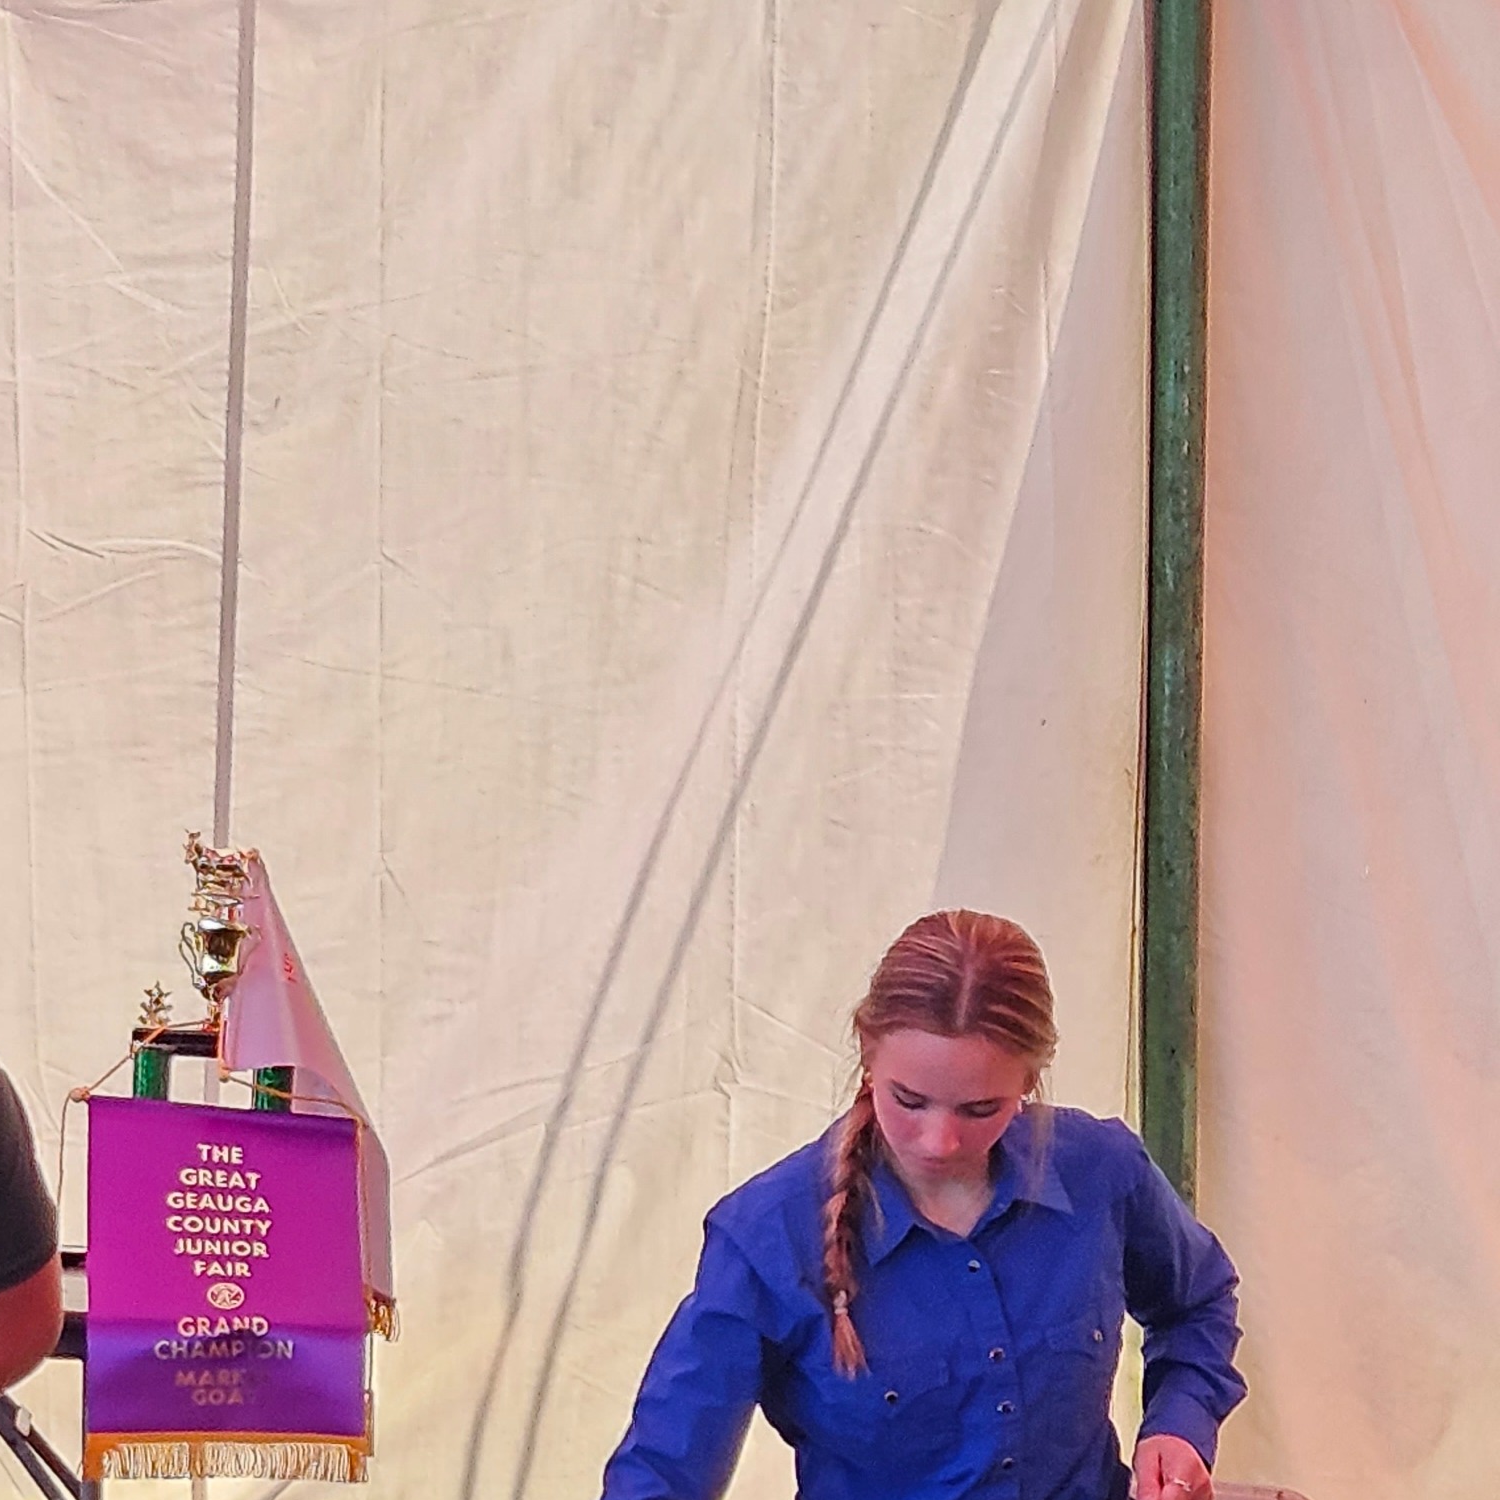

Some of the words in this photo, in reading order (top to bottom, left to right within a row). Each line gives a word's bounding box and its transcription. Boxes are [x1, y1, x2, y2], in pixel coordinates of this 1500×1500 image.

[197, 1143, 244, 1165] THE
[179, 1168, 261, 1191] GREAT
[166, 1192, 272, 1214] GEAUGA
[165, 1215, 272, 1236] COUNTY
[174, 1238, 269, 1258] JUNIOR
[193, 1260, 252, 1278] FAIR
[177, 1316, 269, 1337] GRAND
[153, 1339, 294, 1360] CHAMPON
[174, 1368, 250, 1388] MARK
[191, 1388, 246, 1406] GOA
